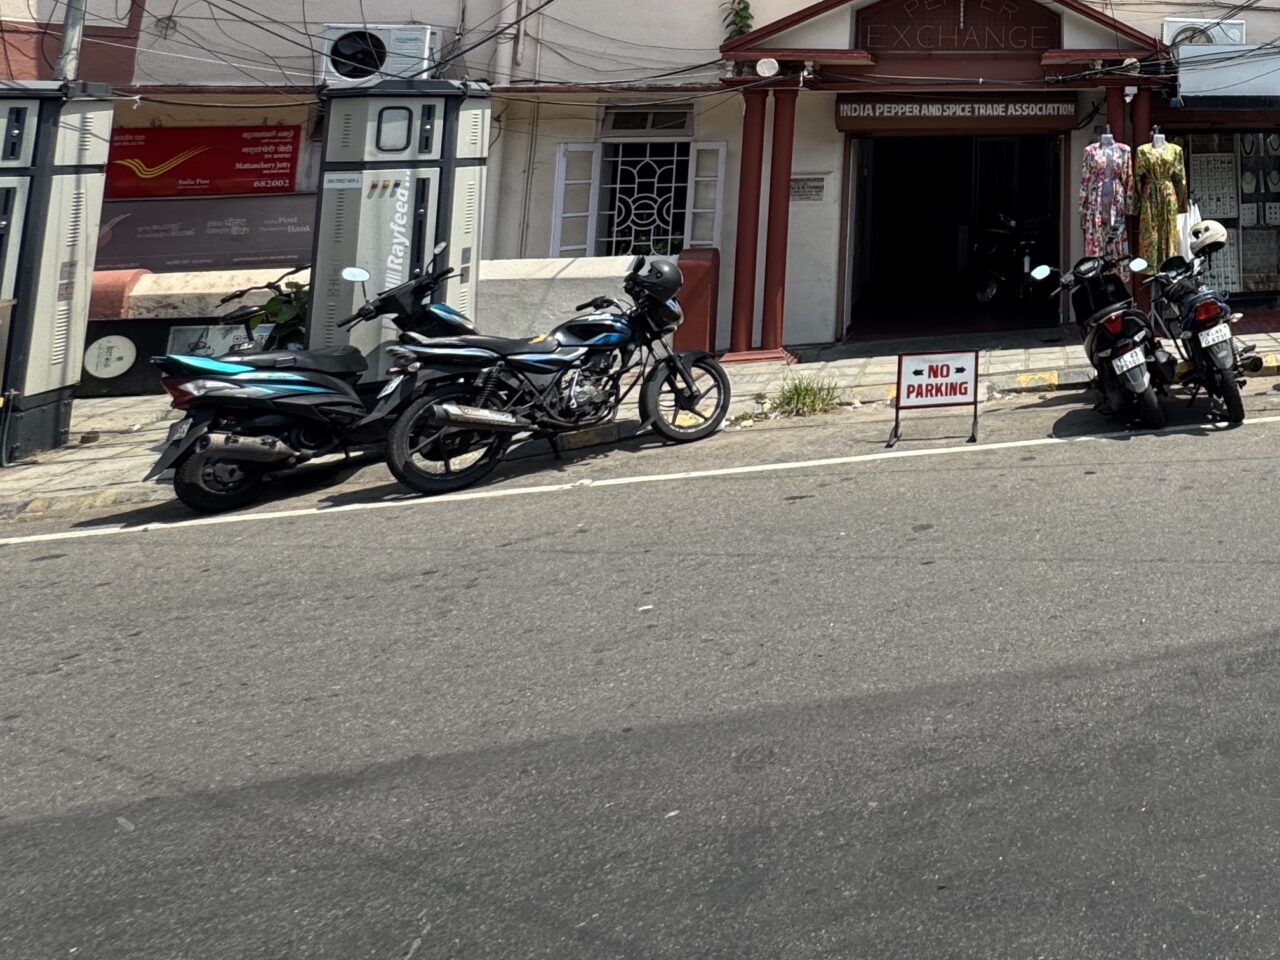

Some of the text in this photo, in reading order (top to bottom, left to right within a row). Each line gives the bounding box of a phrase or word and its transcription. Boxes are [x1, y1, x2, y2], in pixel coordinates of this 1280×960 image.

[867, 24, 1049, 49] EXCHANGE
[839, 103, 1075, 117] INDIA PEPPER AND SPICE TRADE ASSOCIATION
[253, 179, 290, 188] 682002
[928, 364, 951, 379] NO
[906, 381, 969, 399] PARKING
